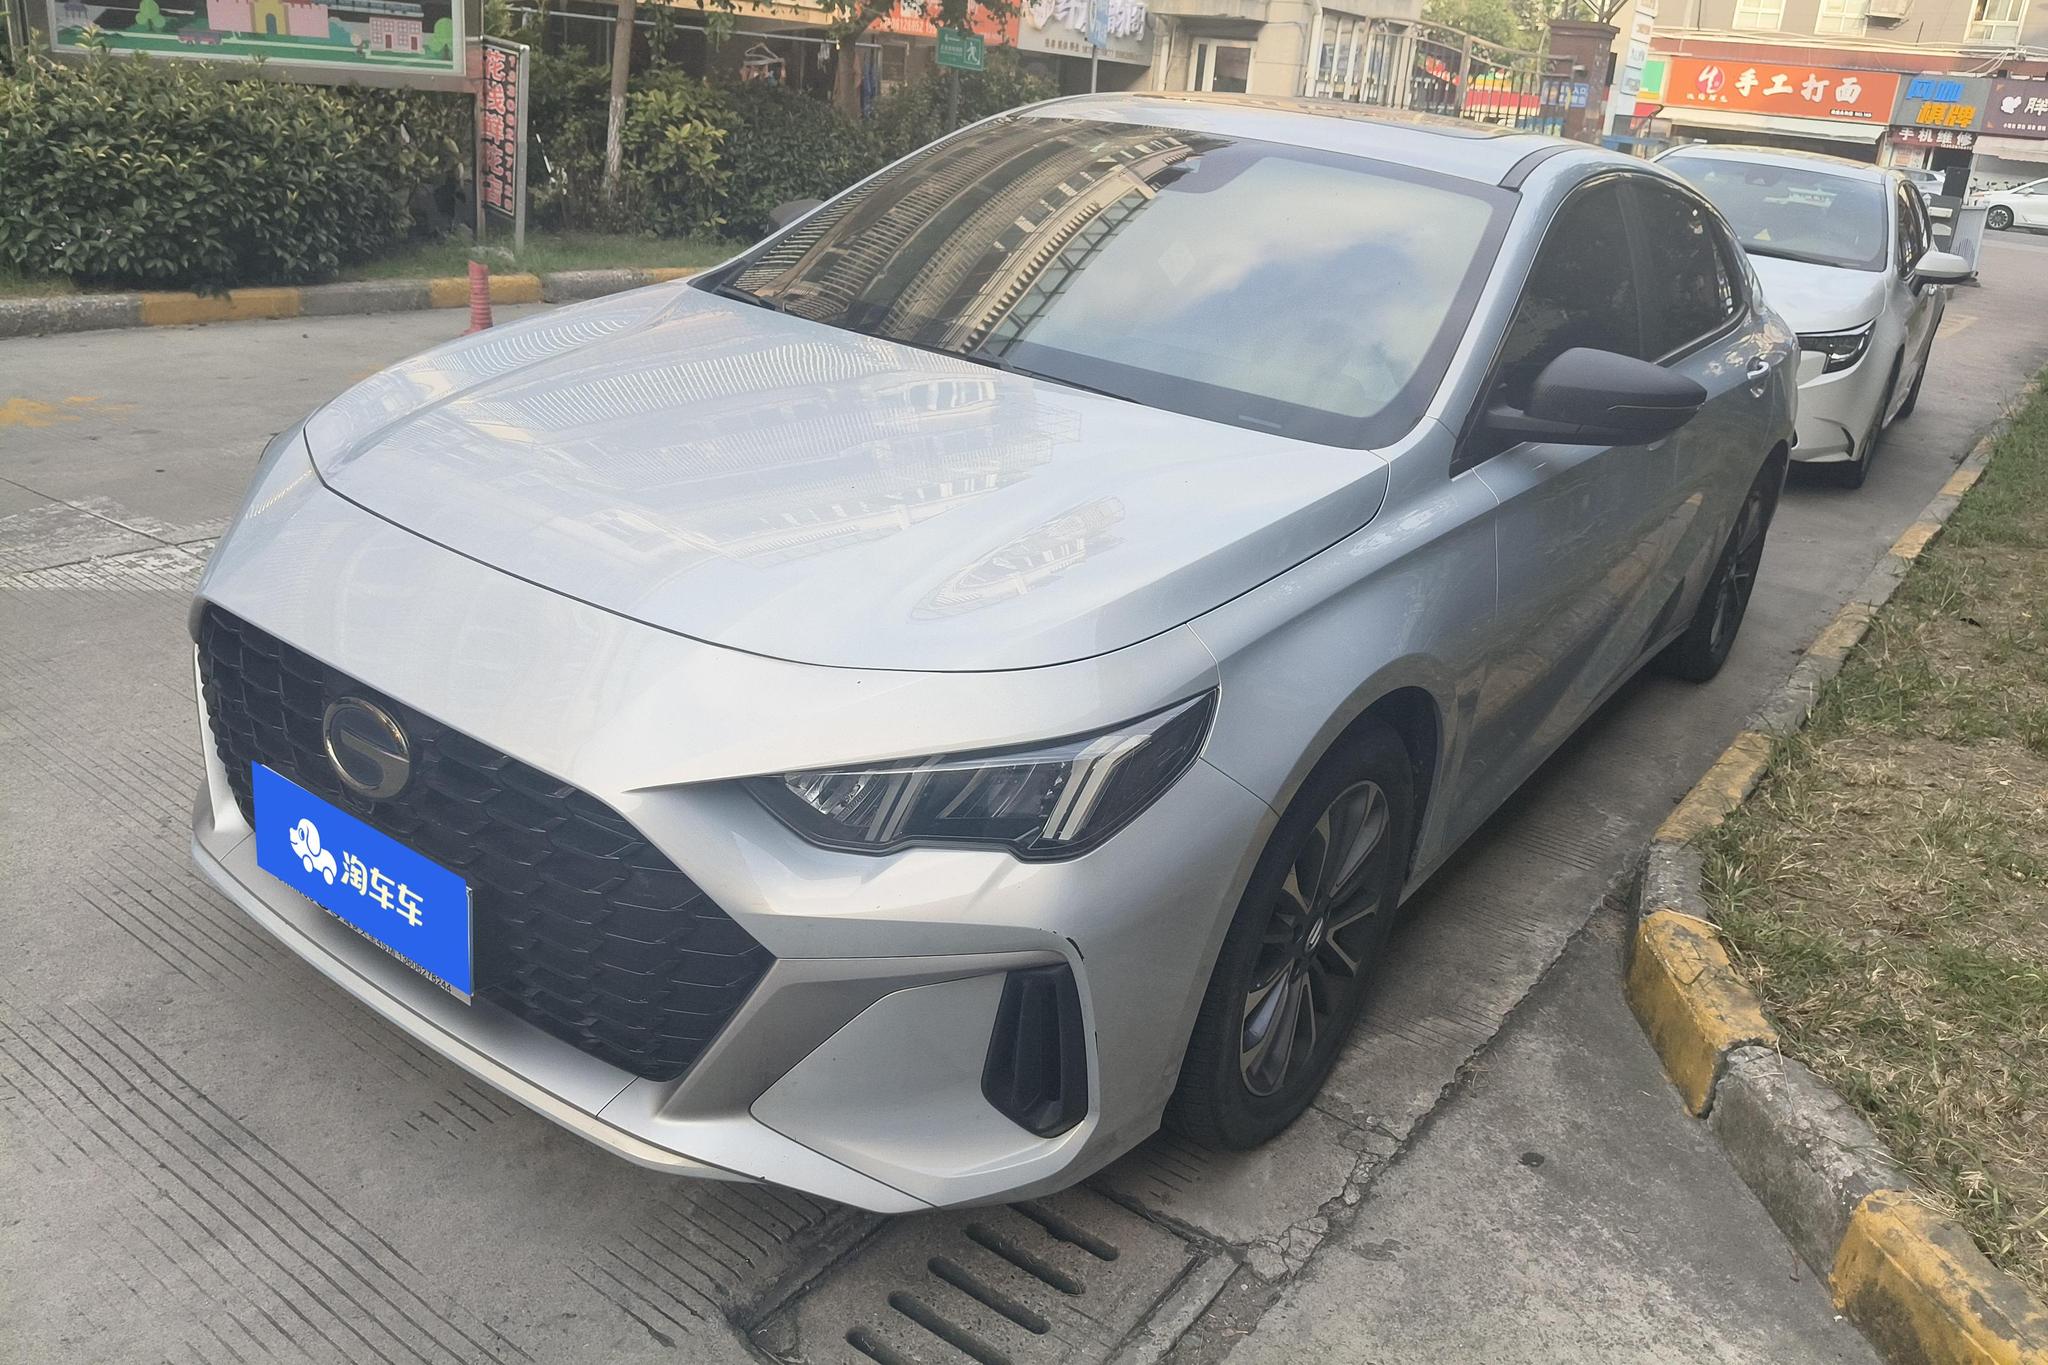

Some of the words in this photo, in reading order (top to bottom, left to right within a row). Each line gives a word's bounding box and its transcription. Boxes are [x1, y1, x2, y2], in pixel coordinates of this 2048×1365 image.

[1734, 67, 1862, 104] 手工打面
[1916, 102, 1976, 128] 棋牌
[2023, 96, 2048, 116] 胖
[1898, 127, 1973, 146] 手机维修
